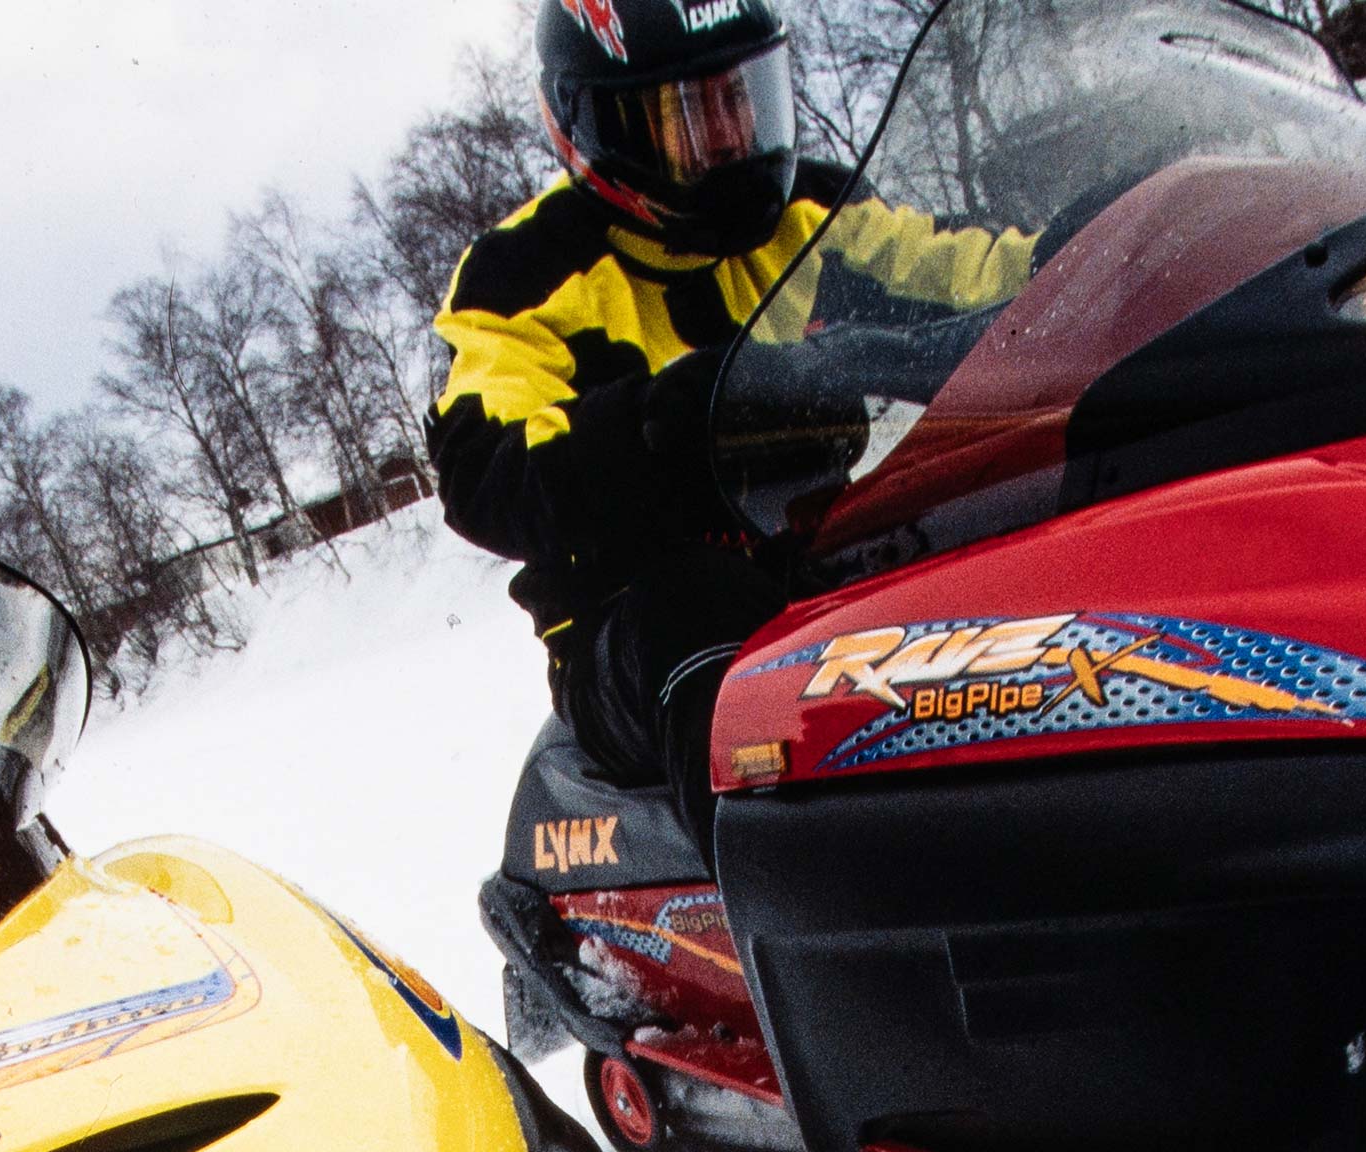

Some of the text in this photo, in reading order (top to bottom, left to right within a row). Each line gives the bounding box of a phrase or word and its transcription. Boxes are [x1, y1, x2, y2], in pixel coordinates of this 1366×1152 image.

[689, 0, 741, 33] LYNX
[799, 612, 1082, 712] RAVE
[534, 815, 620, 874] LYNX
